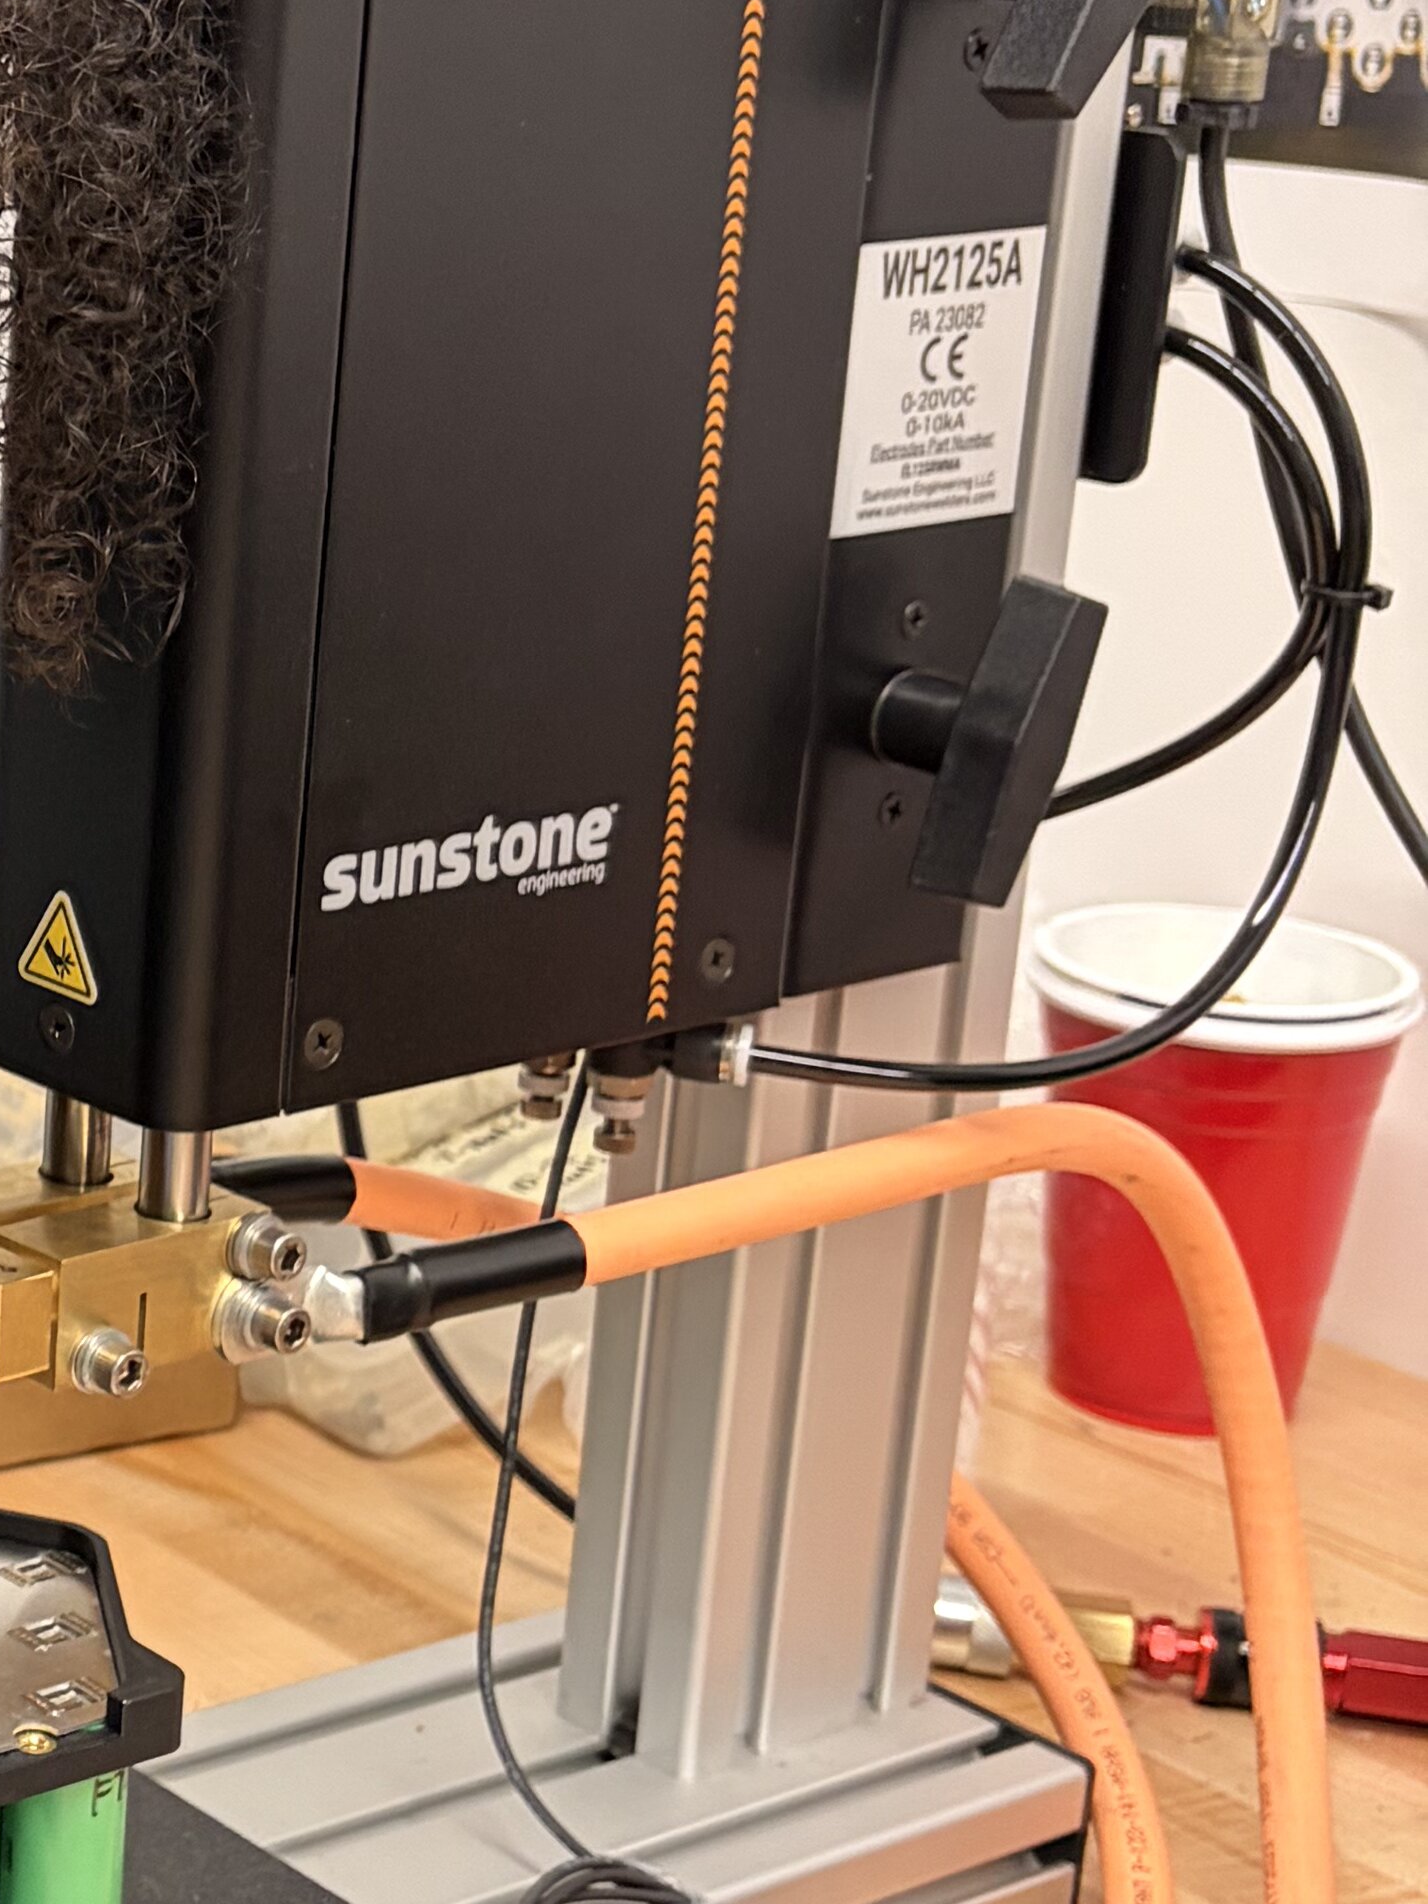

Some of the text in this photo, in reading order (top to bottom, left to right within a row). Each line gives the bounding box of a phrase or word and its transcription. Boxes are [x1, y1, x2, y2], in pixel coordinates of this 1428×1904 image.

[883, 238, 1022, 300] WH2125A
[909, 302, 986, 335] PA 23082
[901, 385, 976, 415] 0-20VDC
[906, 412, 965, 438] 0-10kA
[321, 806, 614, 911] sunstone
[517, 861, 606, 896] engineering
